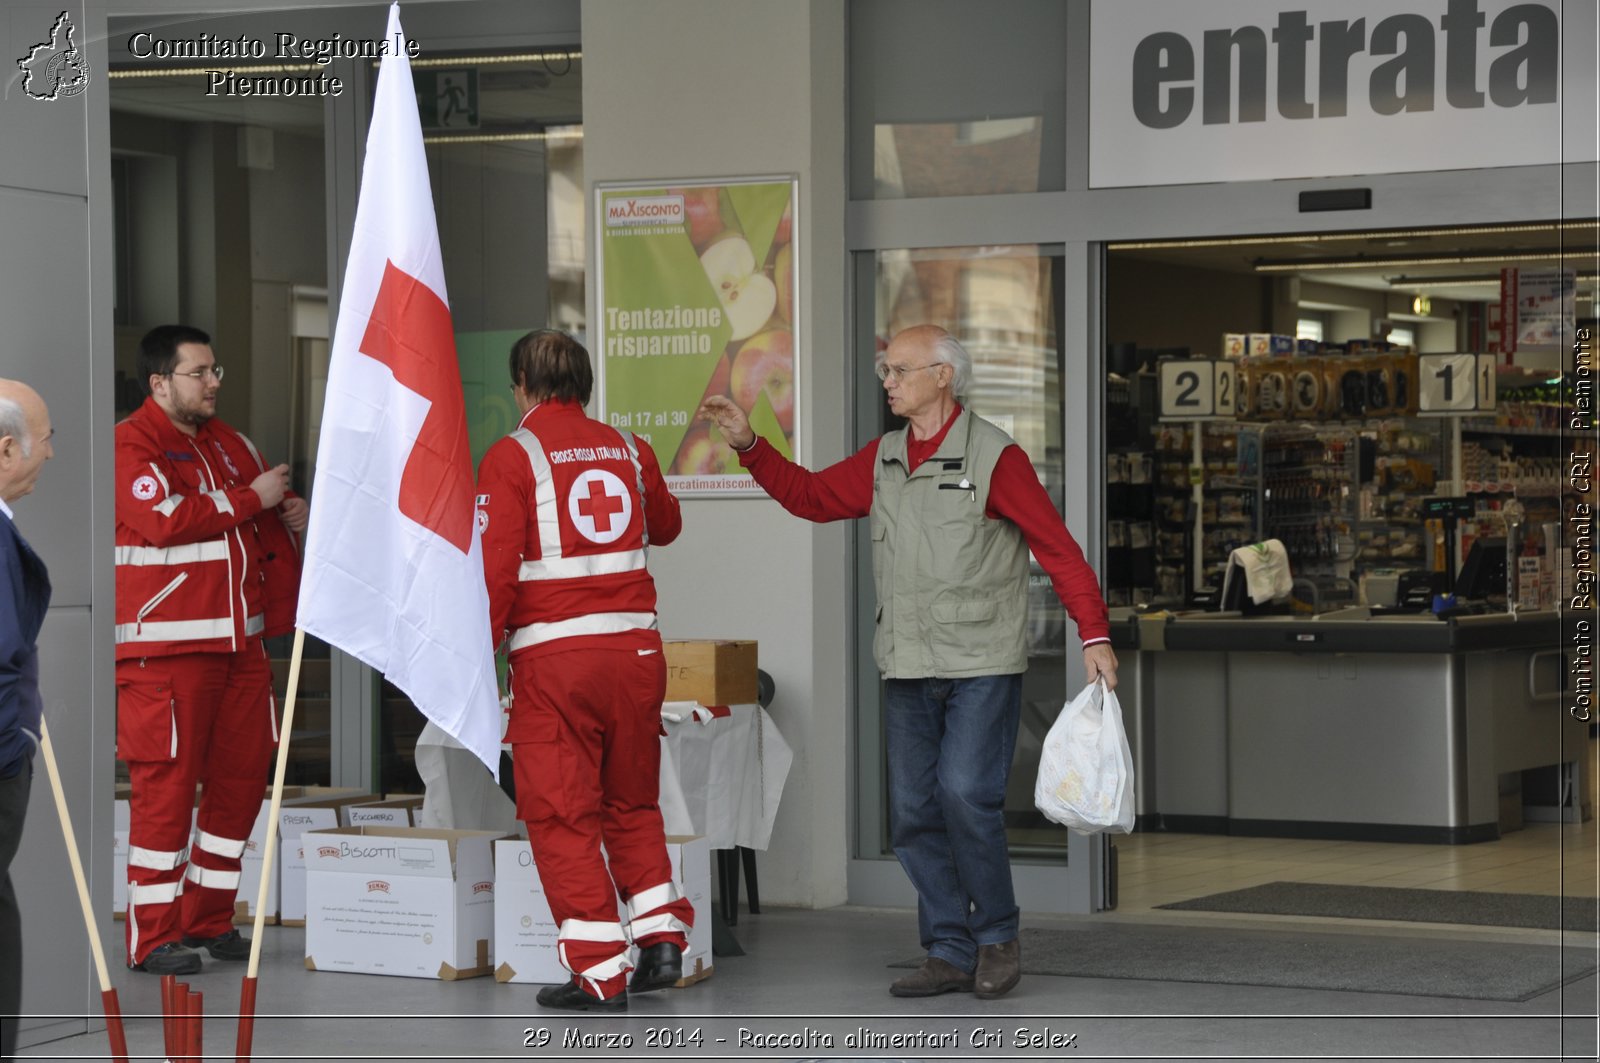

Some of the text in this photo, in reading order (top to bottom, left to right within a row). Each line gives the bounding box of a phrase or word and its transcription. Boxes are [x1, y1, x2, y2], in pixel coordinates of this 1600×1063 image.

[1132, 0, 1558, 130] entrata
[606, 305, 721, 331] Tentazione
[607, 331, 711, 358] risparmio
[1174, 371, 1200, 406] 2
[1220, 371, 1230, 406] 2
[1435, 364, 1453, 401] 1
[1482, 364, 1490, 401] 1
[611, 411, 687, 427] Dal 17 al 30
[550, 445, 629, 465] CROCE ROSSA ITALIANA
[283, 815, 313, 825] PASTA
[341, 842, 396, 858] BISCOTTI
